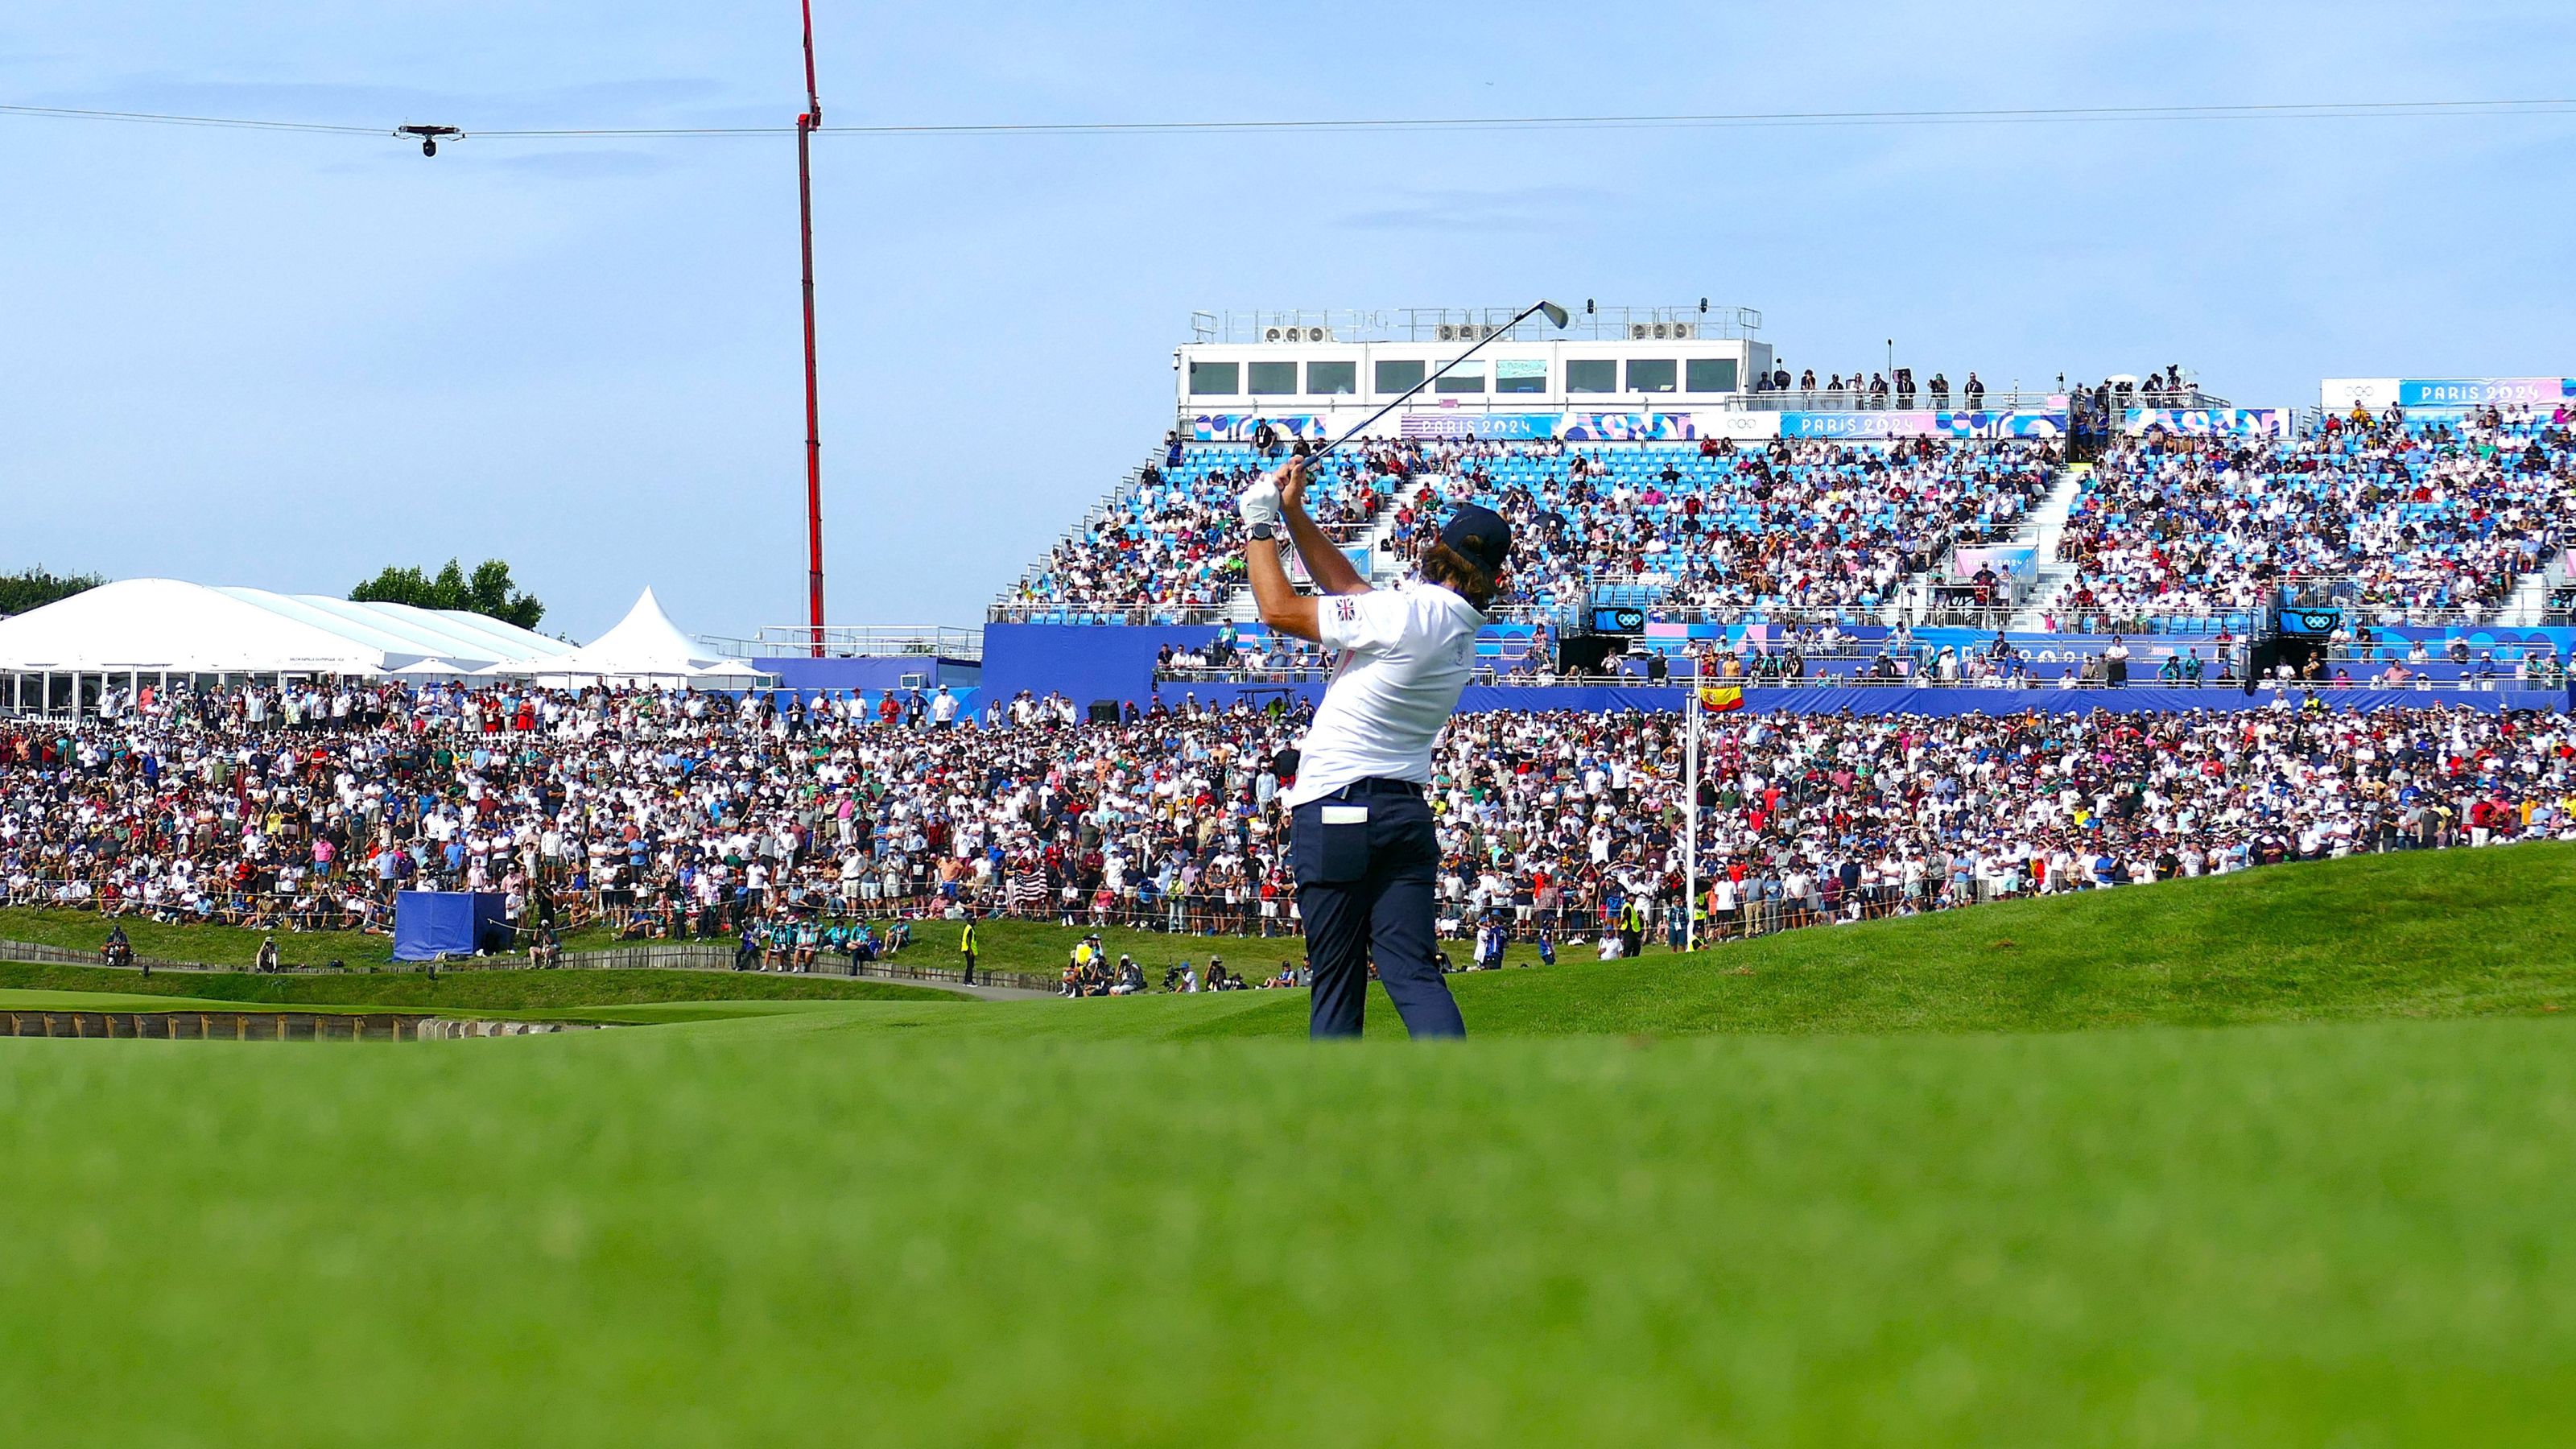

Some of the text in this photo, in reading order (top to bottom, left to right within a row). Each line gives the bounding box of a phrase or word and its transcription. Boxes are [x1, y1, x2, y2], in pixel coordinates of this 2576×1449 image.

[2421, 386, 2538, 400] PARIS 2024
[1422, 420, 1530, 433] PARIS 2024
[1802, 419, 1913, 432] PARIS 2024
